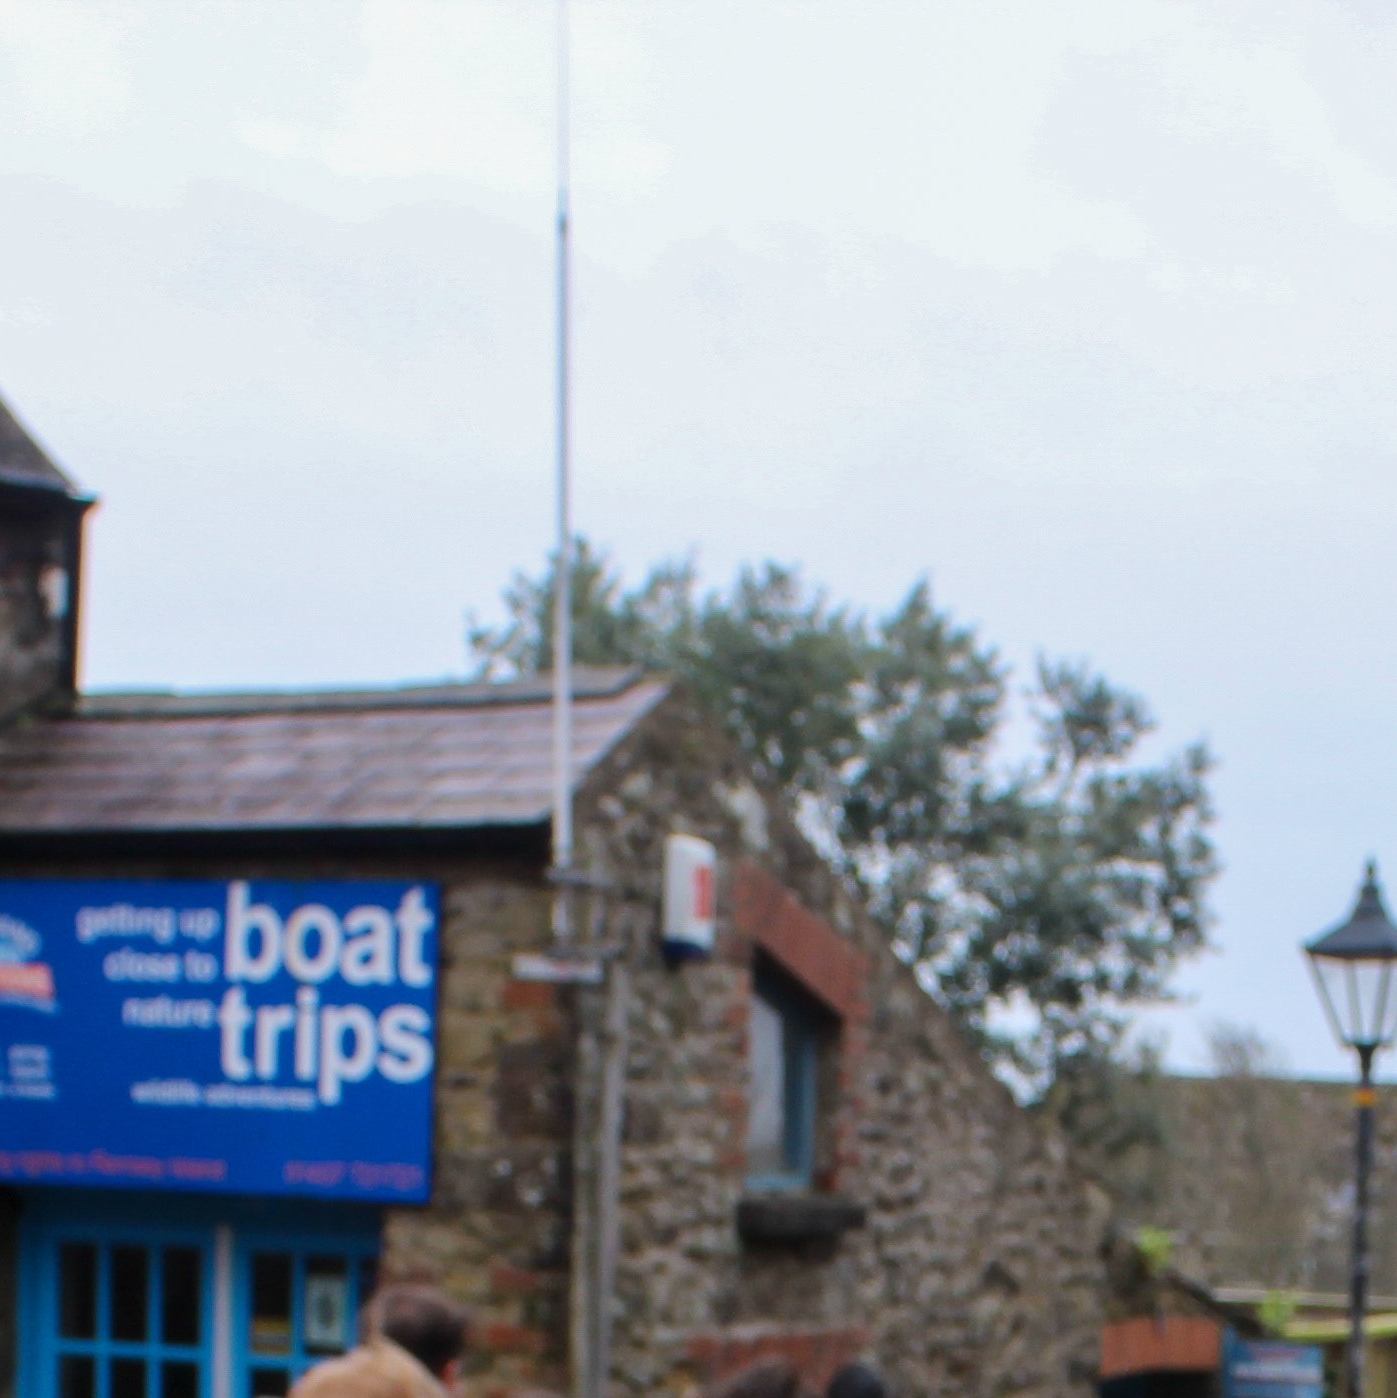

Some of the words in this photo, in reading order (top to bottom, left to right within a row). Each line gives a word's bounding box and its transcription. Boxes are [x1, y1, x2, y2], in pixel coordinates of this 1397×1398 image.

[75, 904, 176, 943] getting
[180, 907, 220, 942] up
[225, 880, 434, 988] boat
[104, 947, 180, 983] close
[184, 949, 218, 983] to
[122, 994, 216, 1028] nature
[219, 985, 434, 1107] trips
